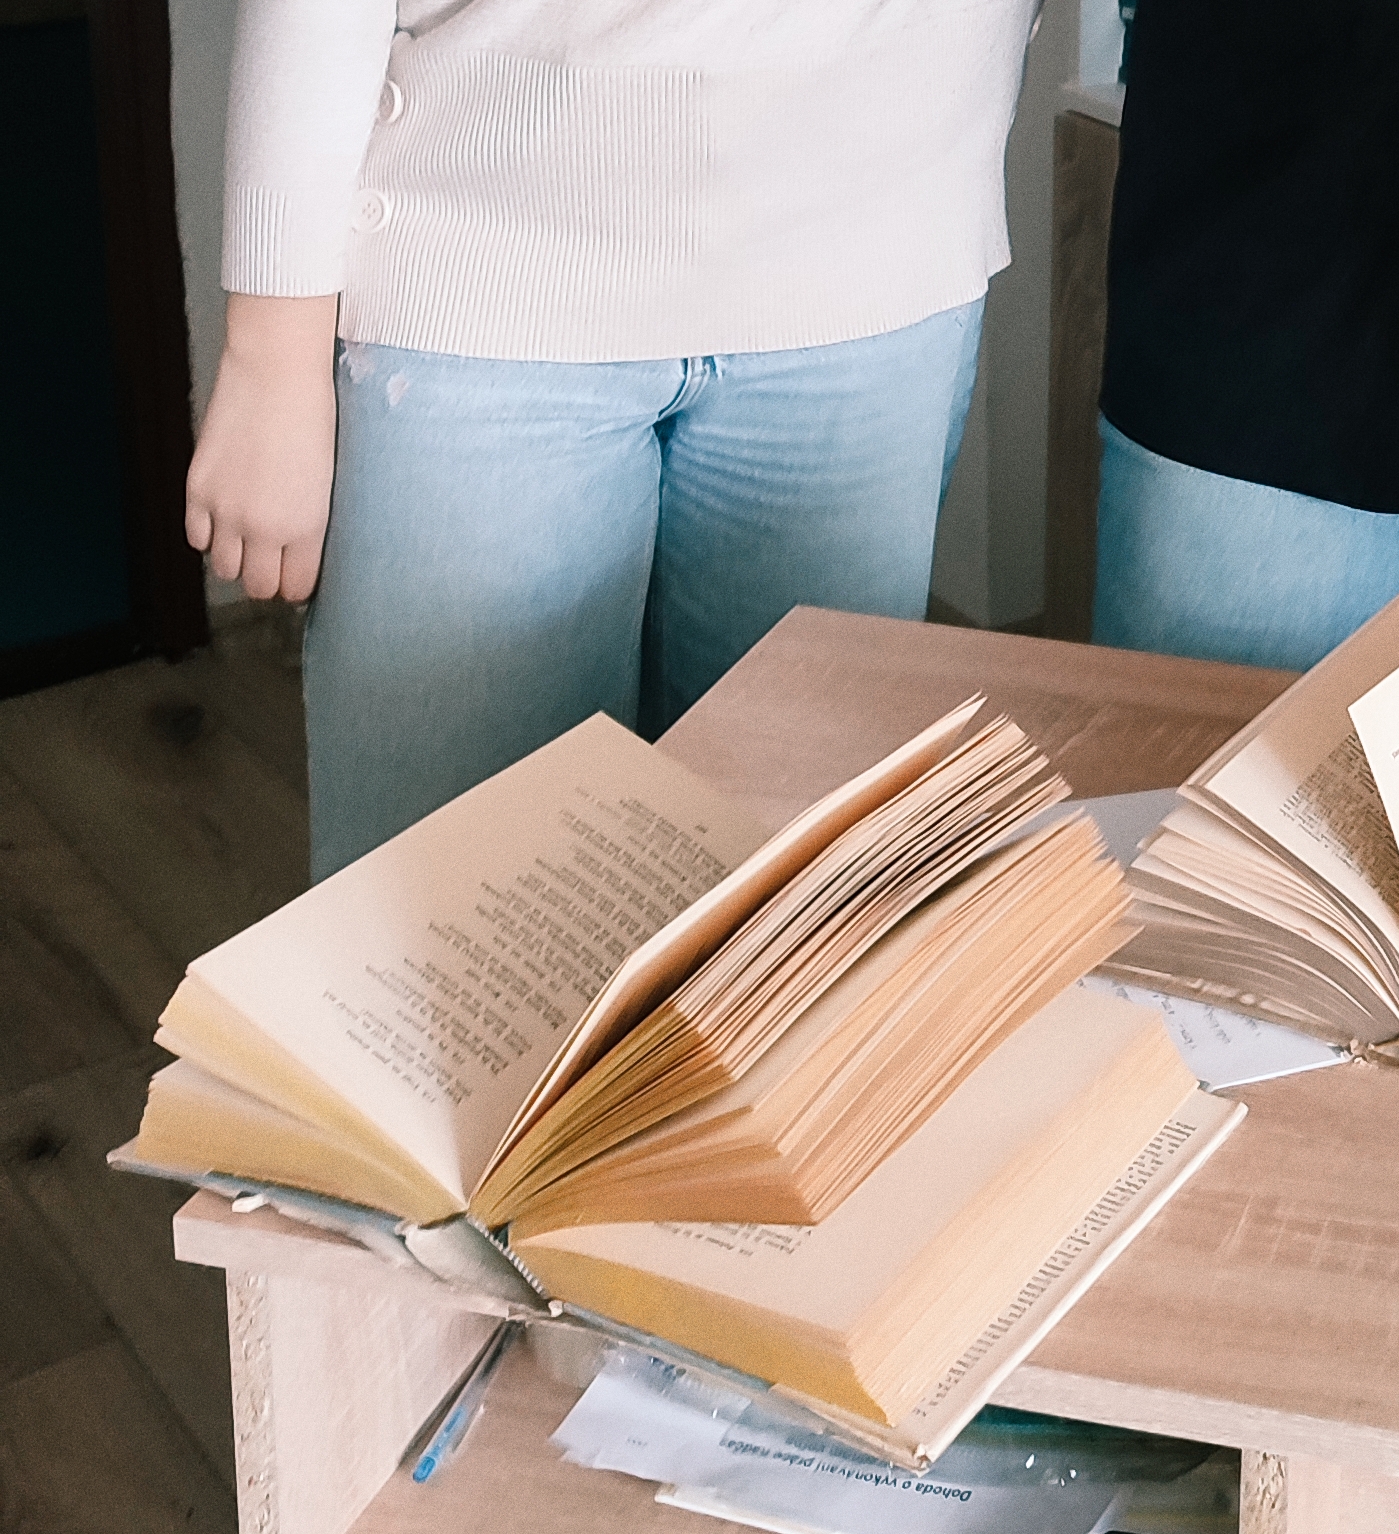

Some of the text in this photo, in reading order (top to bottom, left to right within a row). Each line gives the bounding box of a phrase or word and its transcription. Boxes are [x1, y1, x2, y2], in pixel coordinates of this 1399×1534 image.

[772, 1448, 816, 1468] práce
[816, 1459, 899, 1488] vykonávaní
[902, 1479, 912, 1490] o
[914, 1481, 973, 1502] Dohoda
